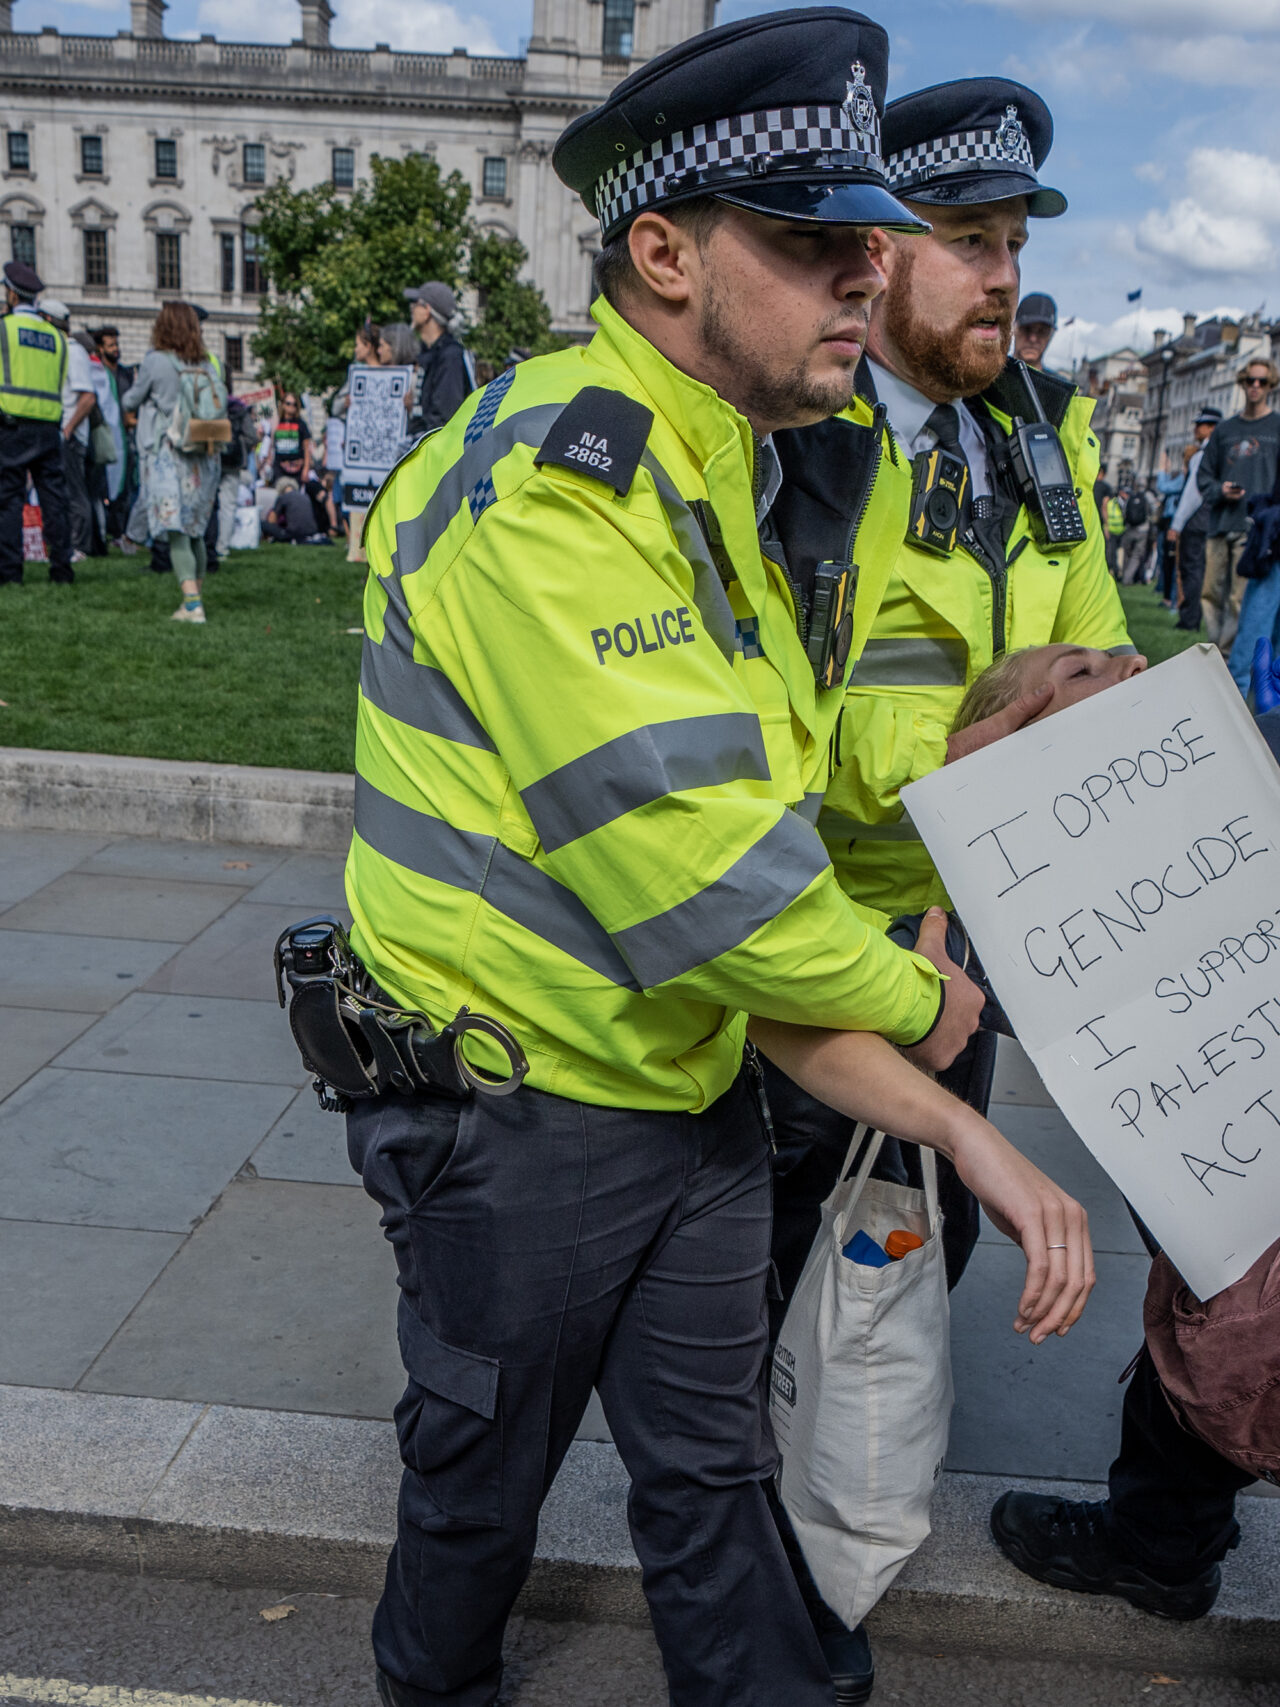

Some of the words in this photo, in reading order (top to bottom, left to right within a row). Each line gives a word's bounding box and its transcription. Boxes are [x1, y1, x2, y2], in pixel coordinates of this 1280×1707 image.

[563, 444, 613, 472] 2862
[579, 431, 608, 453] NA
[590, 606, 696, 666] POLICE
[967, 810, 1051, 898] I
[1053, 717, 1216, 839] OPPOSE
[1024, 815, 1269, 988] GENOCIDE
[1075, 1014, 1137, 1071] I
